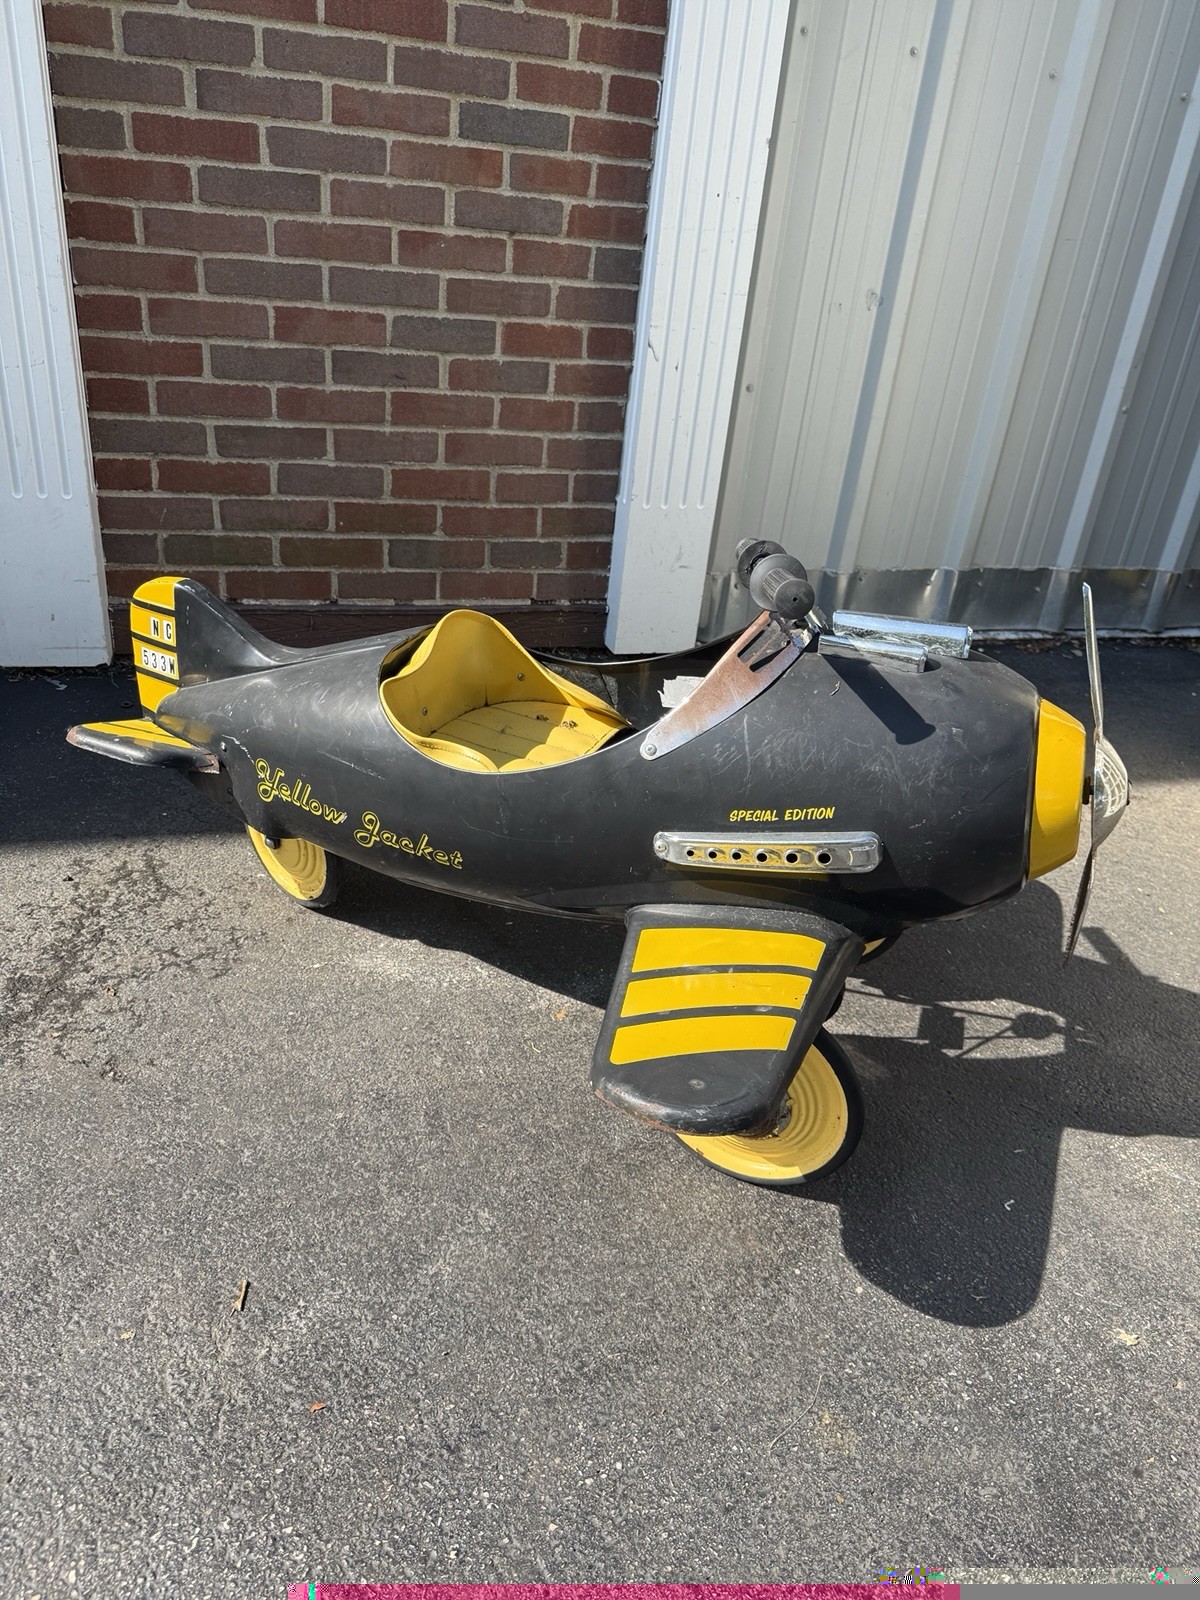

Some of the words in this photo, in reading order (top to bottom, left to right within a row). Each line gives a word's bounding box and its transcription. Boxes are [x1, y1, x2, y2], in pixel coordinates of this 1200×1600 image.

[255, 758, 345, 824] Yellow
[354, 812, 463, 869] Jacket
[729, 809, 779, 822] SPECIAL
[784, 807, 835, 821] EDITION
